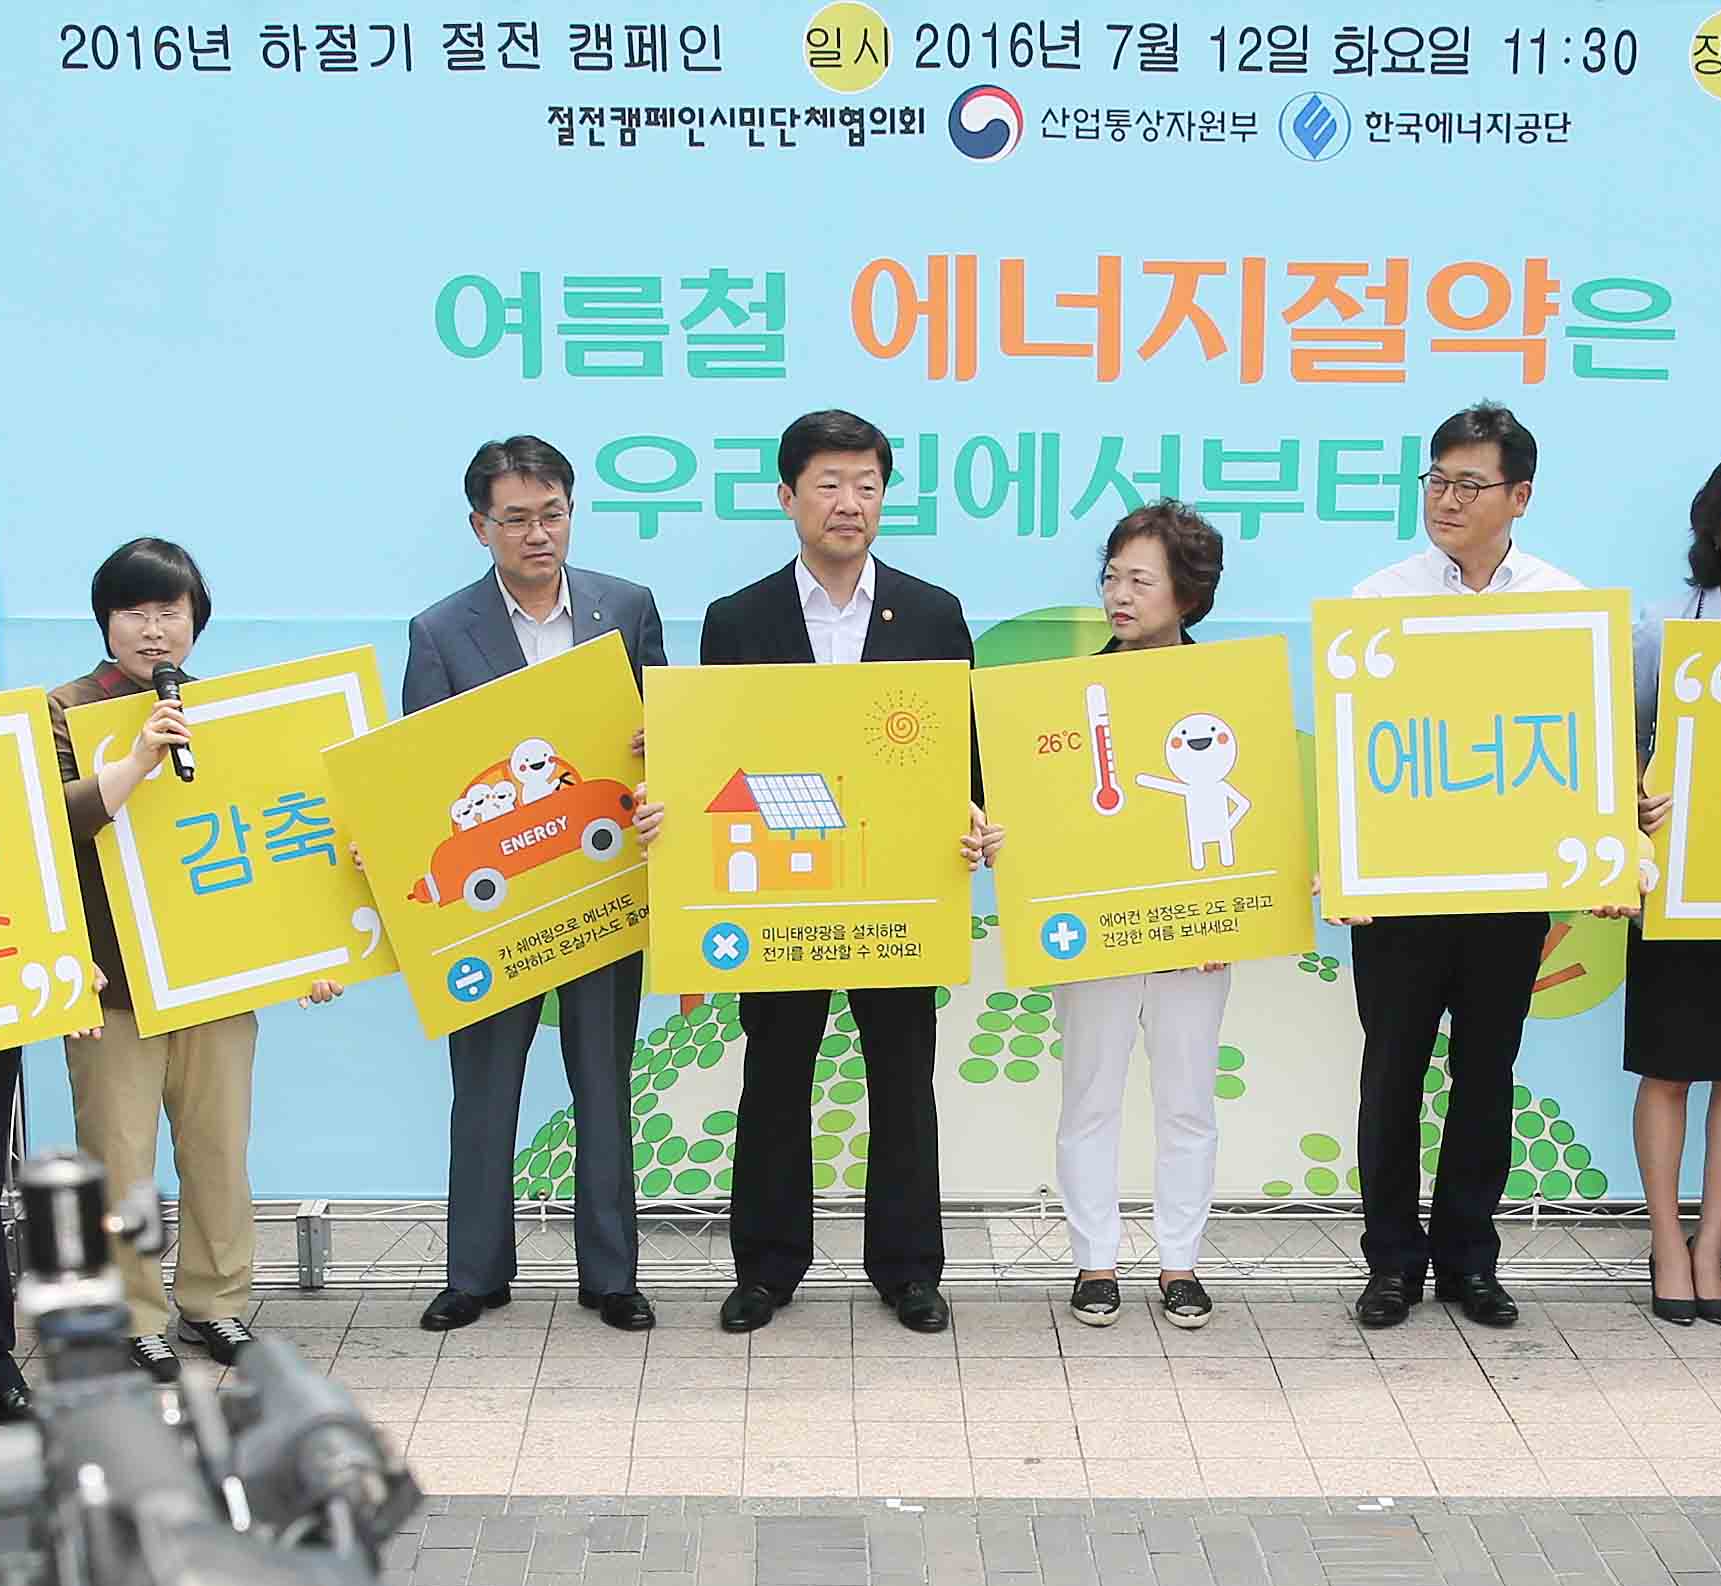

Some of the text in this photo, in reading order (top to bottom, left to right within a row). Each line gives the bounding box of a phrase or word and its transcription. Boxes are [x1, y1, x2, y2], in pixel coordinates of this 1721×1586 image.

[60, 20, 723, 73] 2016년 하절기 절전 캠페인
[806, 18, 1638, 78] 일시 2016년 7월 12일 화요일 11:30
[547, 105, 925, 148] 절전캠페인시민단체협의회
[1040, 106, 1259, 144] 산업통상자원부
[1364, 110, 1572, 145] 한국에너지공단
[434, 254, 1676, 385] 여름철 에너지절약은
[1036, 729, 1083, 757] 26°C
[1366, 711, 1579, 799] 에너지
[175, 791, 338, 895] 감축
[500, 817, 569, 856] ENERGY
[498, 893, 634, 961] 카 쉐어링으로 에너지도
[1098, 895, 1274, 928] 에어컨 설정온도 2도 올리고
[504, 948, 557, 980] 절약하고
[559, 918, 624, 956] 온실가스도
[761, 923, 908, 942] 미니태양광을 설치하면
[762, 942, 922, 962] 전기를 생산할 수 있어요!
[1102, 919, 1240, 949] 건강한 여름 보내세요!
